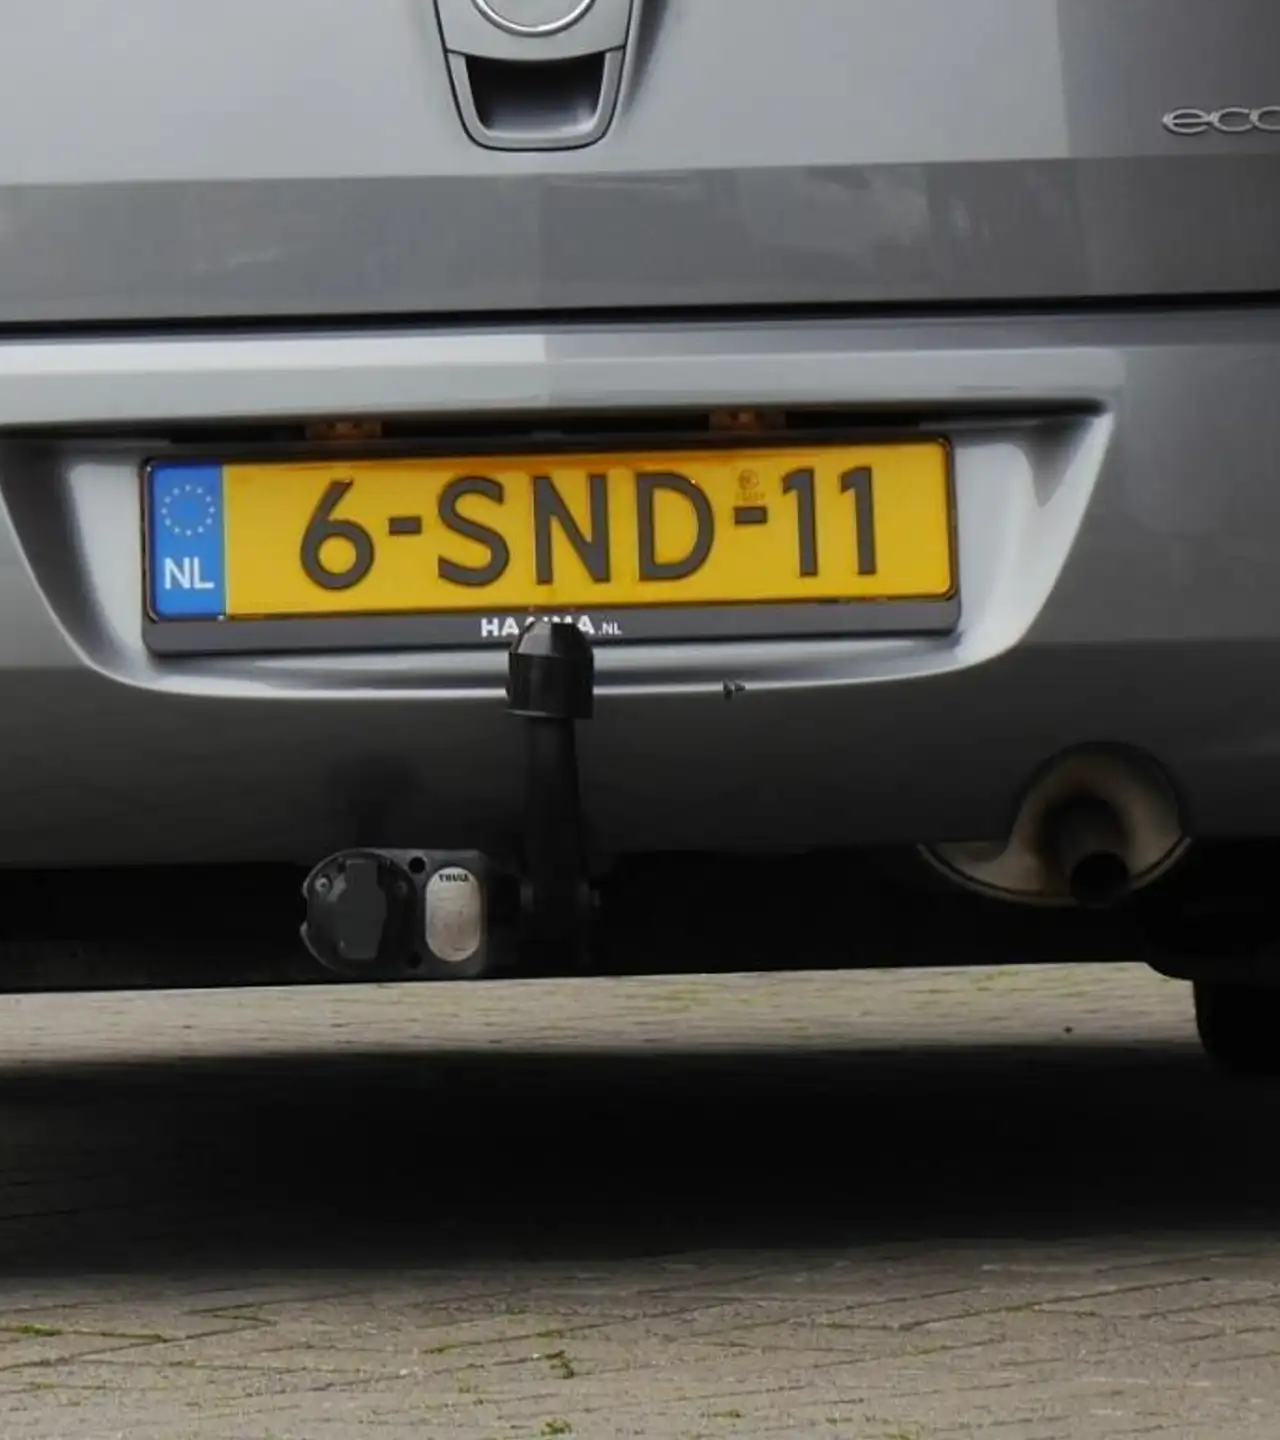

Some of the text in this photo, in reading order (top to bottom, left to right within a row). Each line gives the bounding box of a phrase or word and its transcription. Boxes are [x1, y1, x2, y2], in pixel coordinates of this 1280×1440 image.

[299, 465, 879, 591] 6-SND-11
[164, 557, 215, 591] NL
[481, 615, 622, 637] HAA.NL
